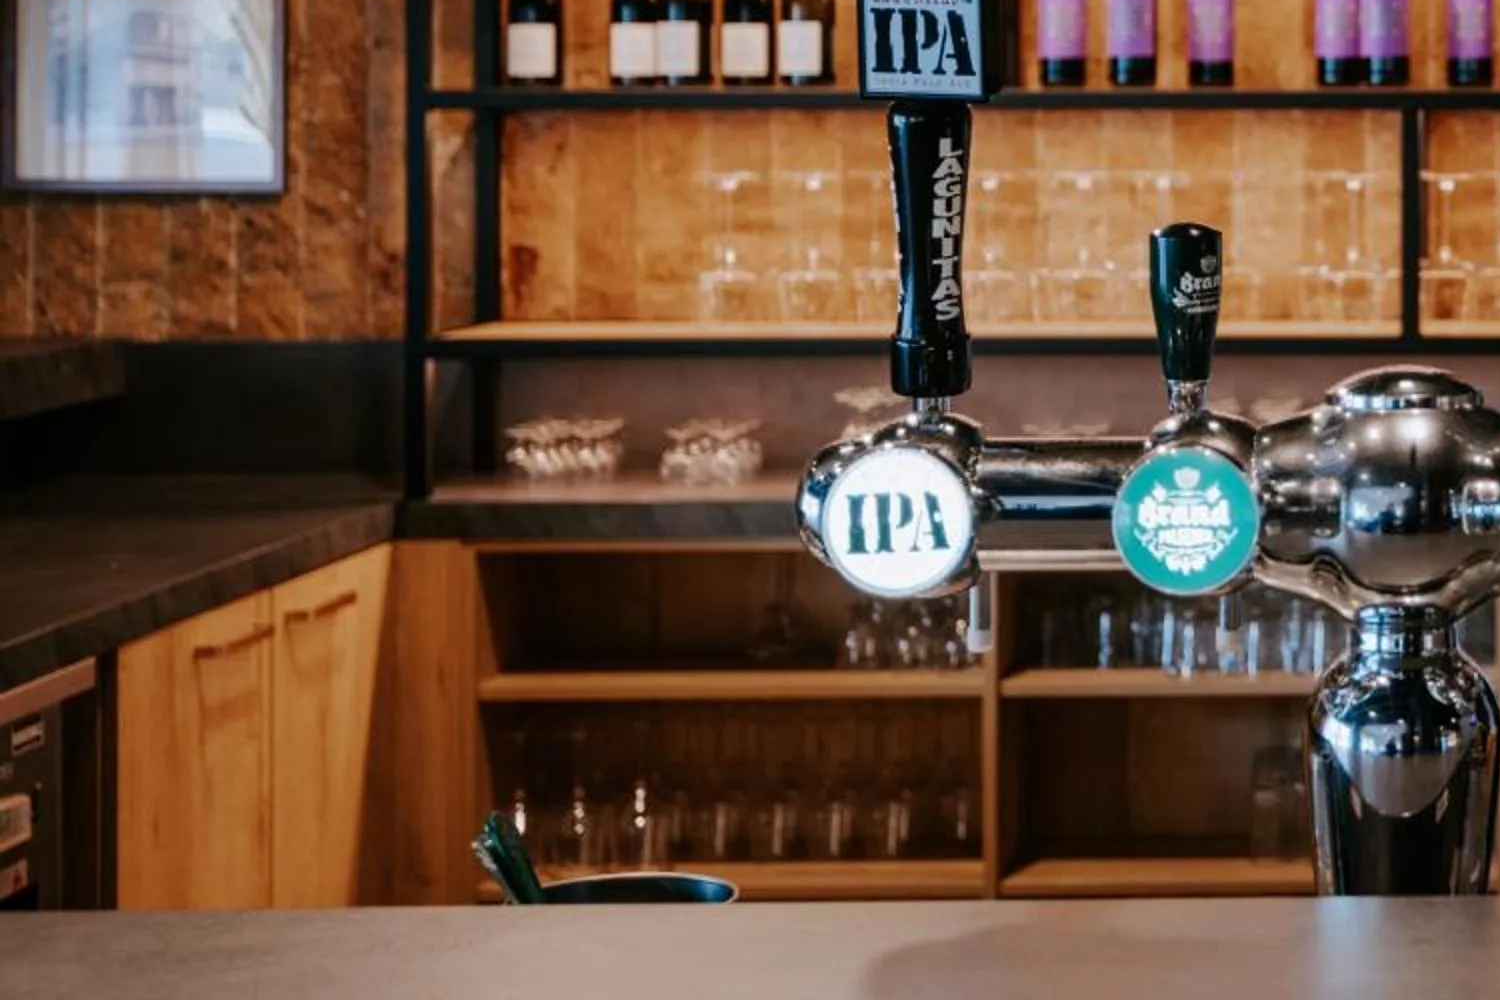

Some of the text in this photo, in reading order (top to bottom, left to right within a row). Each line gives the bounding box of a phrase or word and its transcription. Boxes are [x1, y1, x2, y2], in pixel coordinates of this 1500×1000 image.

[869, 7, 977, 77] IPA
[931, 136, 964, 322] LAGUNITAS
[845, 490, 951, 555] IPA
